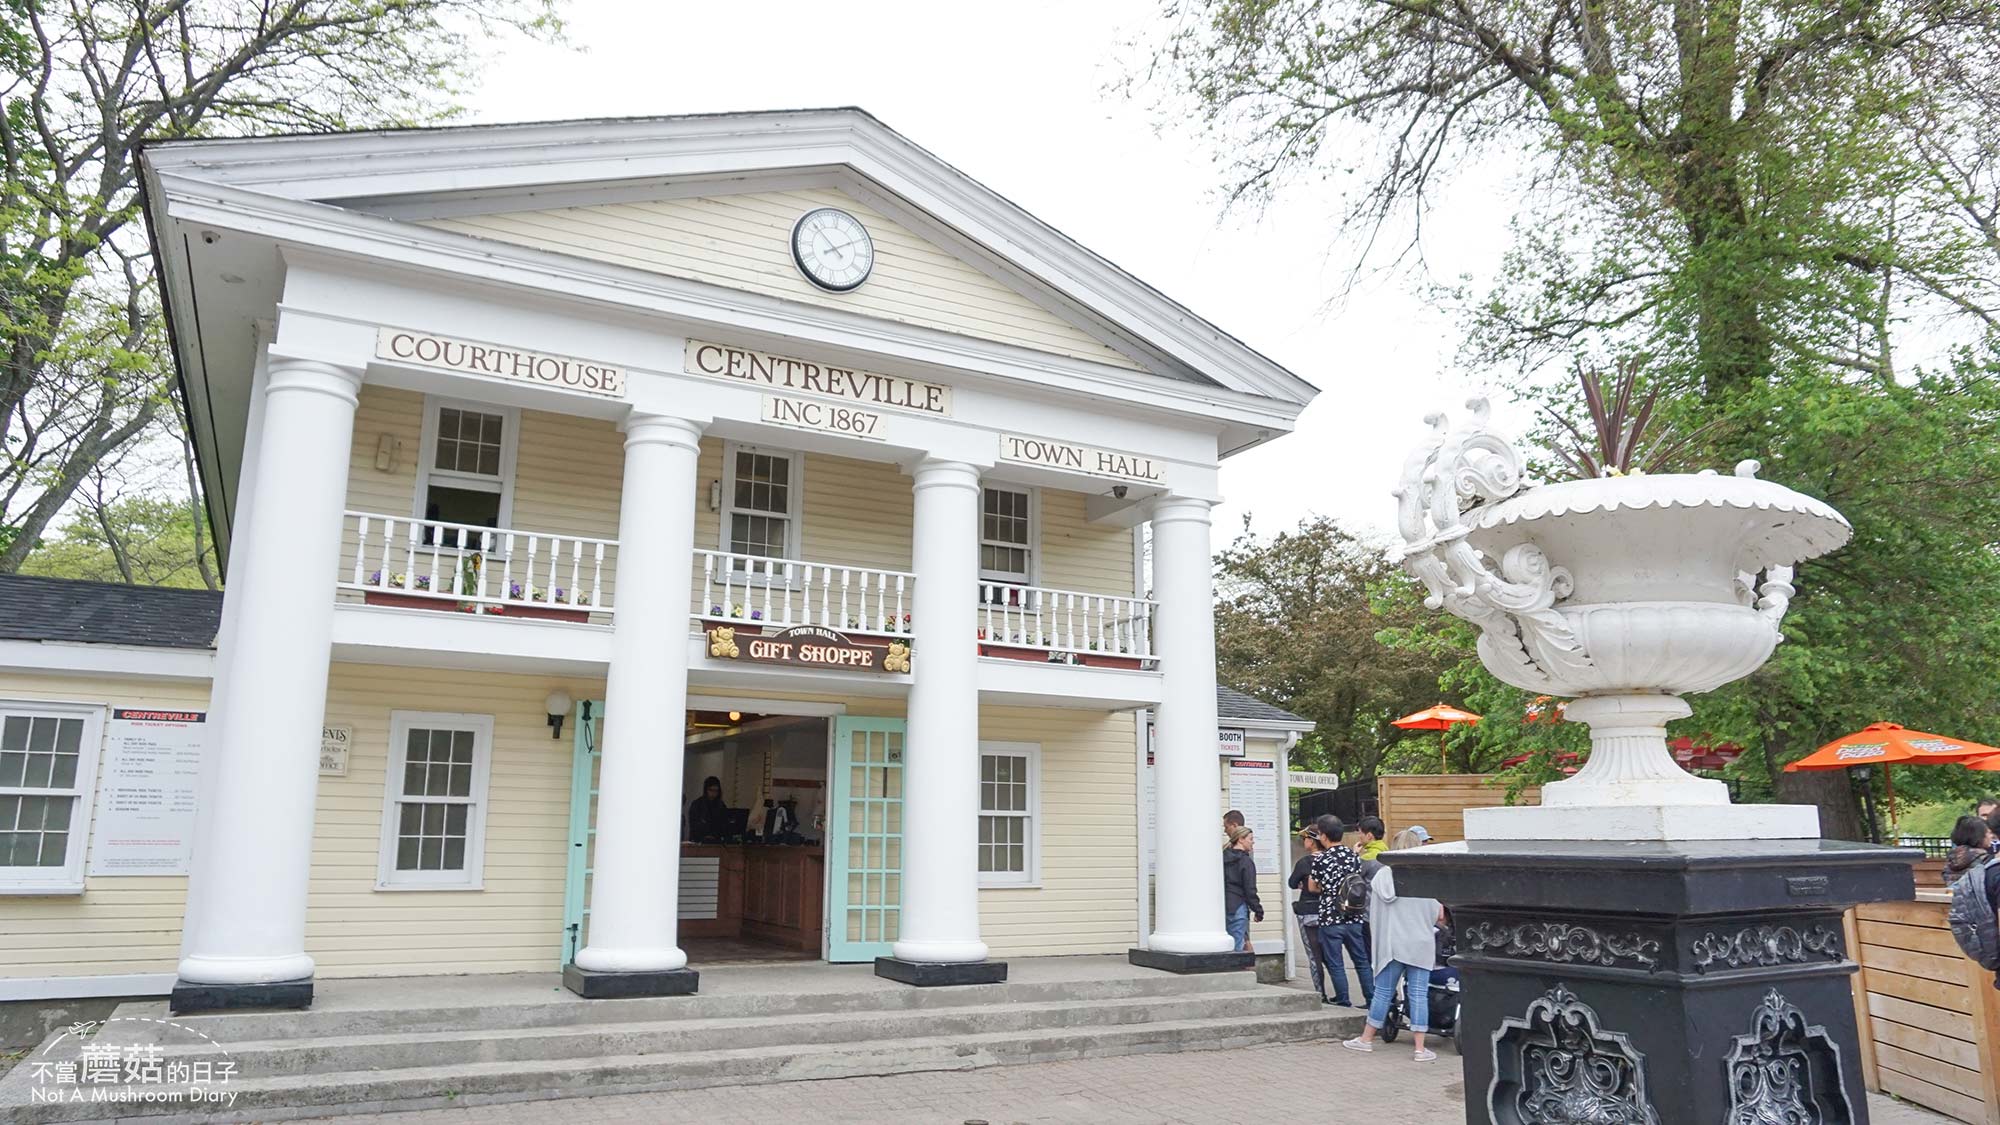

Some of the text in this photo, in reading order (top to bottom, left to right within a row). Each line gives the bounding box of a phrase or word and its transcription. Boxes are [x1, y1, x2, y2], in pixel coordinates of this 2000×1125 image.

[391, 333, 618, 392] COURTHOUSE
[696, 345, 944, 414] CENTREVILLE
[772, 397, 878, 435] INC 1867
[1009, 437, 1159, 480] TOWN HALL
[789, 627, 838, 642] TOWN HALL
[749, 640, 873, 667] GIFT SHOPPE
[121, 710, 199, 722] CENTREVILLE
[1219, 732, 1242, 742] BOOTH
[1221, 743, 1240, 751] TICKETS
[1289, 774, 1335, 785] TOWN HALL OFFICE
